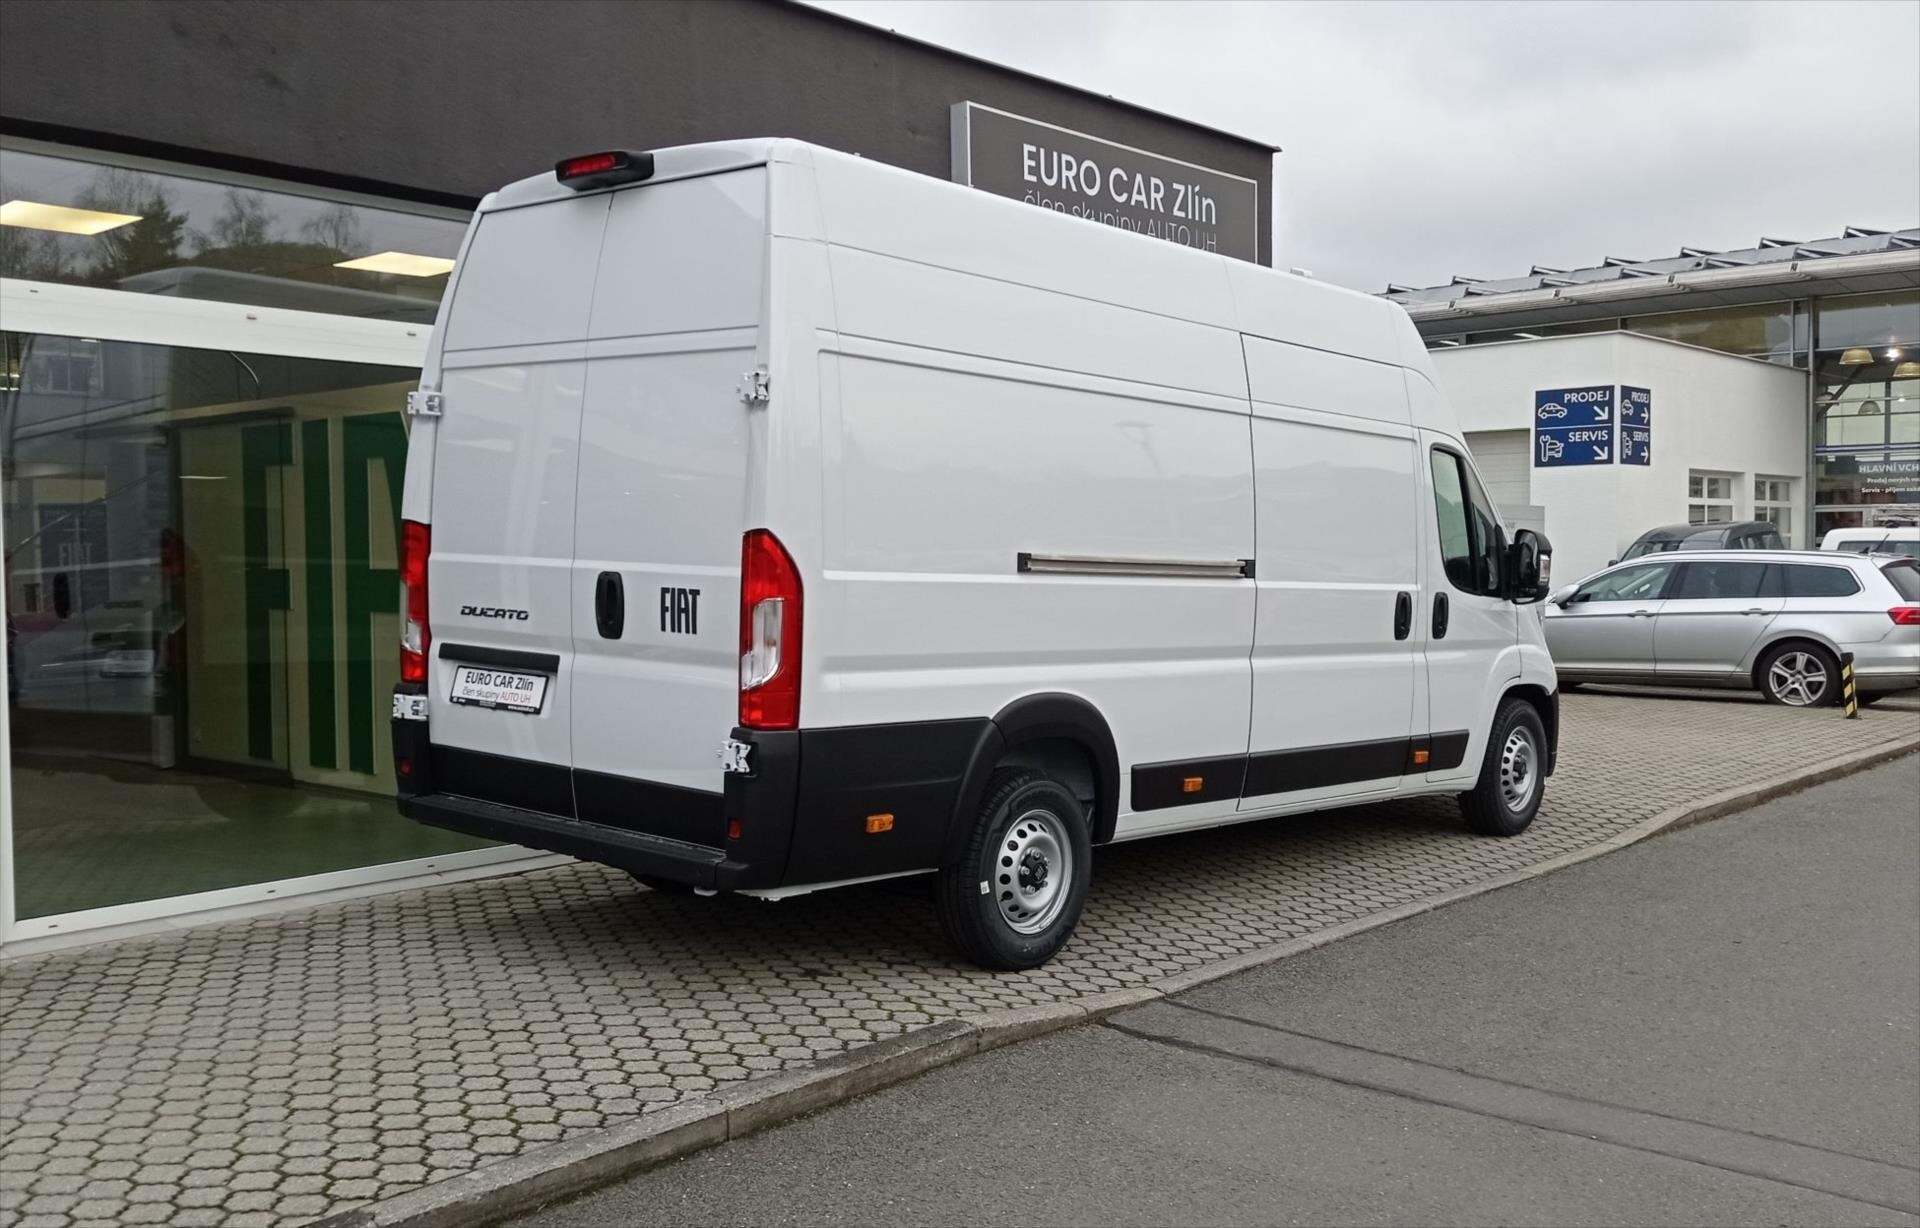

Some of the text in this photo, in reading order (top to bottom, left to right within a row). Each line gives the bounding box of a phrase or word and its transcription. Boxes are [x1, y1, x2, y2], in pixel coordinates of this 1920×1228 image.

[1023, 143, 1217, 225] EURO CAR Zlín
[1564, 390, 1610, 403] PRODEJ
[1631, 391, 1649, 403] PRODEJ
[1568, 430, 1608, 442] SERVIS
[1633, 431, 1649, 442] SERVIS
[1859, 462, 1897, 473] HLAVNÍ
[460, 605, 530, 621] DUCATO
[660, 587, 701, 635] FIAT
[465, 671, 534, 691] EURO CAR Zlín
[500, 691, 520, 702] AUTO
[521, 693, 532, 704] UH
